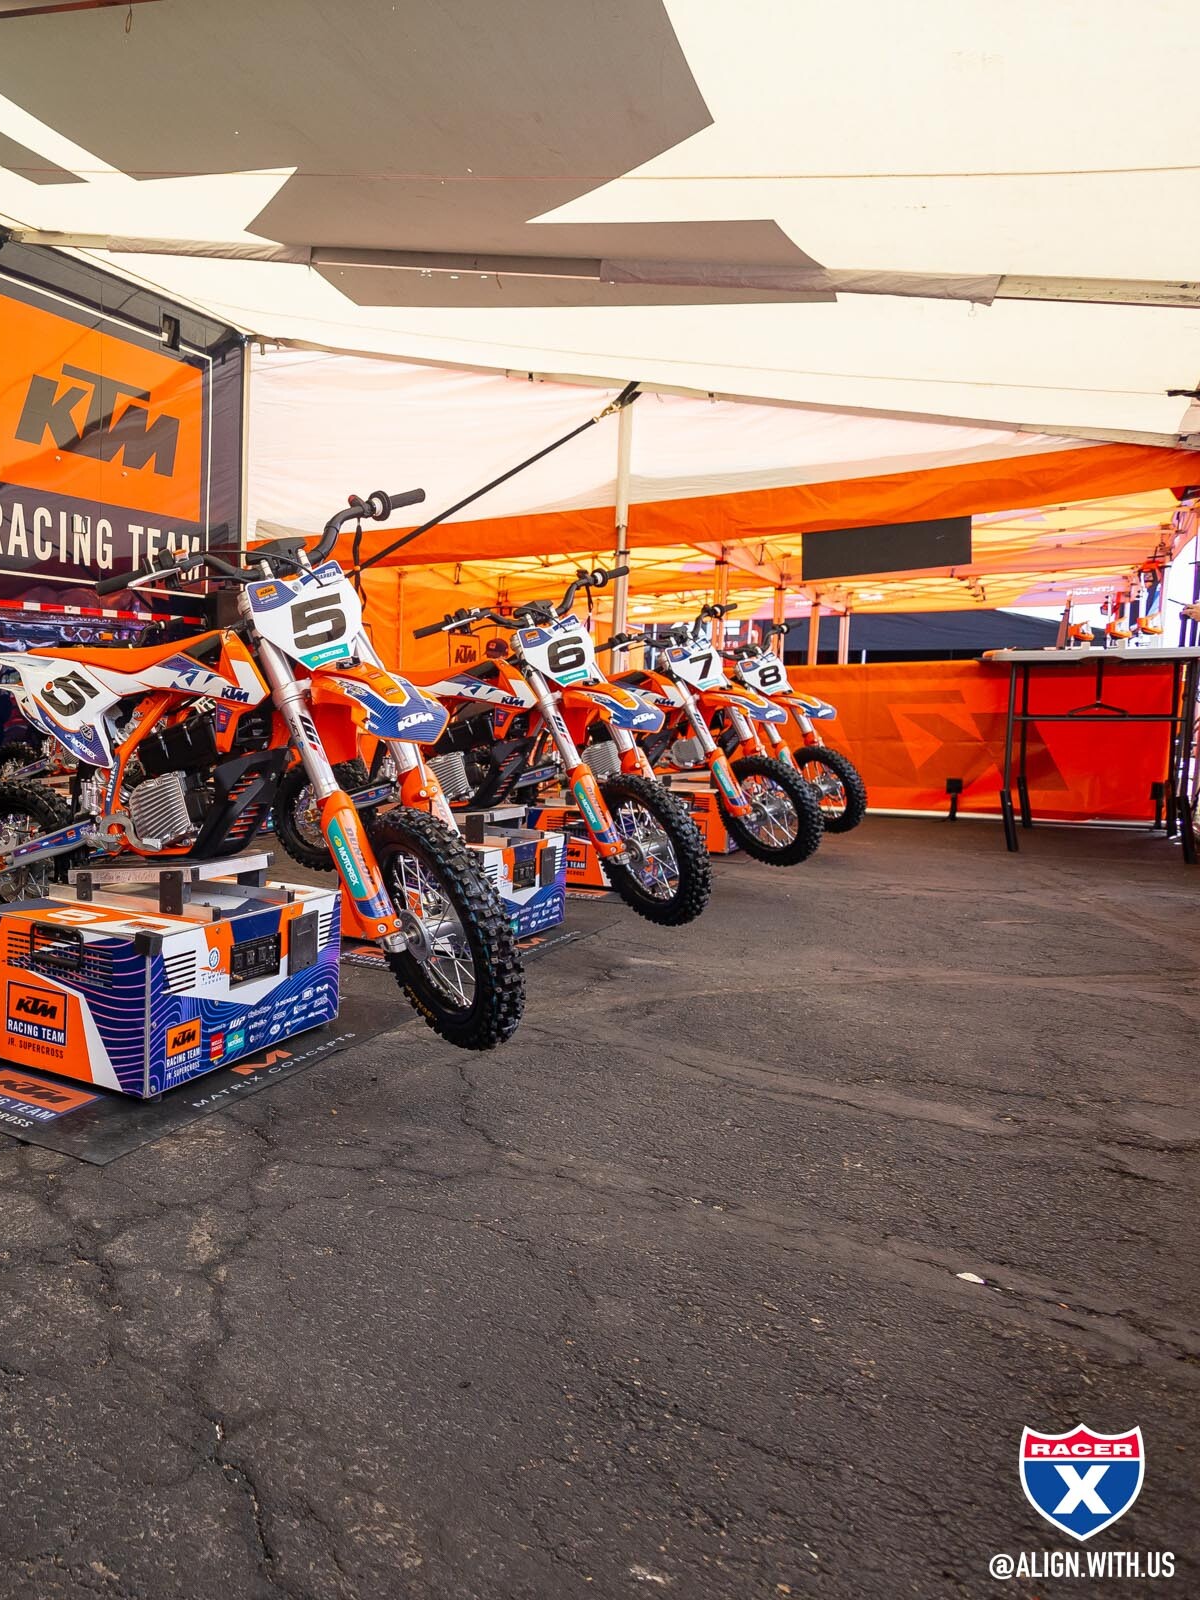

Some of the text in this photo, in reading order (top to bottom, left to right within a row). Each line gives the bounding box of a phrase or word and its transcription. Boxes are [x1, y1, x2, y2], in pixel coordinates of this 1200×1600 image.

[14, 363, 180, 478] KTM
[290, 592, 346, 649] 5
[455, 645, 477, 663] KTM
[547, 636, 585, 673] 6
[689, 653, 712, 680] 7
[758, 665, 781, 686] 8
[41, 670, 100, 716] 5
[221, 686, 249, 703] KTM
[501, 696, 525, 706] KTM
[655, 698, 675, 706] KTM
[397, 712, 435, 732] KTM
[633, 713, 656, 725] KTM
[71, 738, 97, 760] MOTOREX
[338, 847, 359, 886] MOTOREX
[46, 909, 108, 921] 5
[16, 996, 57, 1019] KTM
[8, 1019, 64, 1044] RACING TEAM
[229, 1015, 246, 1029] WP
[8, 1037, 64, 1059] JR. SUPERCROSS
[172, 1029, 196, 1049] KTM
[166, 1047, 200, 1068] RACING TEAM
[173, 1062, 200, 1078] SUPERCROSS
[192, 1033, 356, 1108] MATRIX CONCEPTS
[13, 1102, 57, 1120] TEAM
